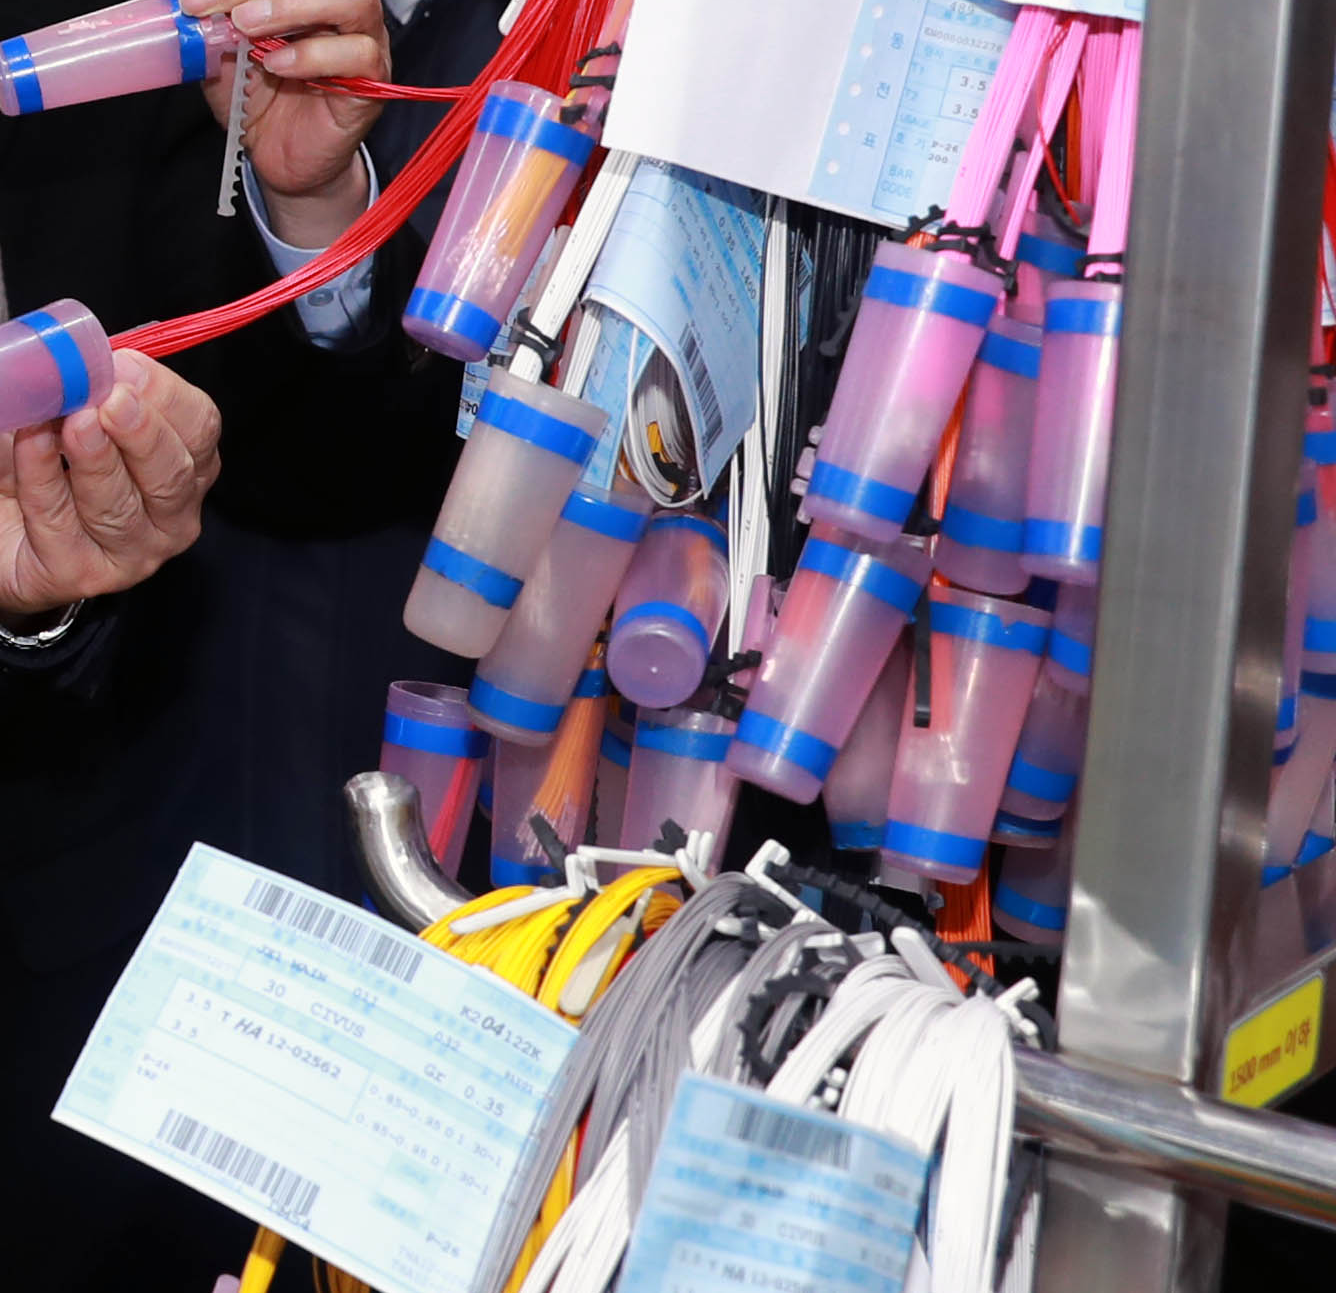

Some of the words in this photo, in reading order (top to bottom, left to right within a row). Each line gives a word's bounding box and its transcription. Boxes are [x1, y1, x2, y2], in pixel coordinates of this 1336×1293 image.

[960, 75, 987, 92] 3.5
[263, 978, 286, 999] 30
[309, 1001, 366, 1039] CIVUS
[463, 1084, 506, 1117] 0.35
[1284, 1017, 1311, 1057] 이하
